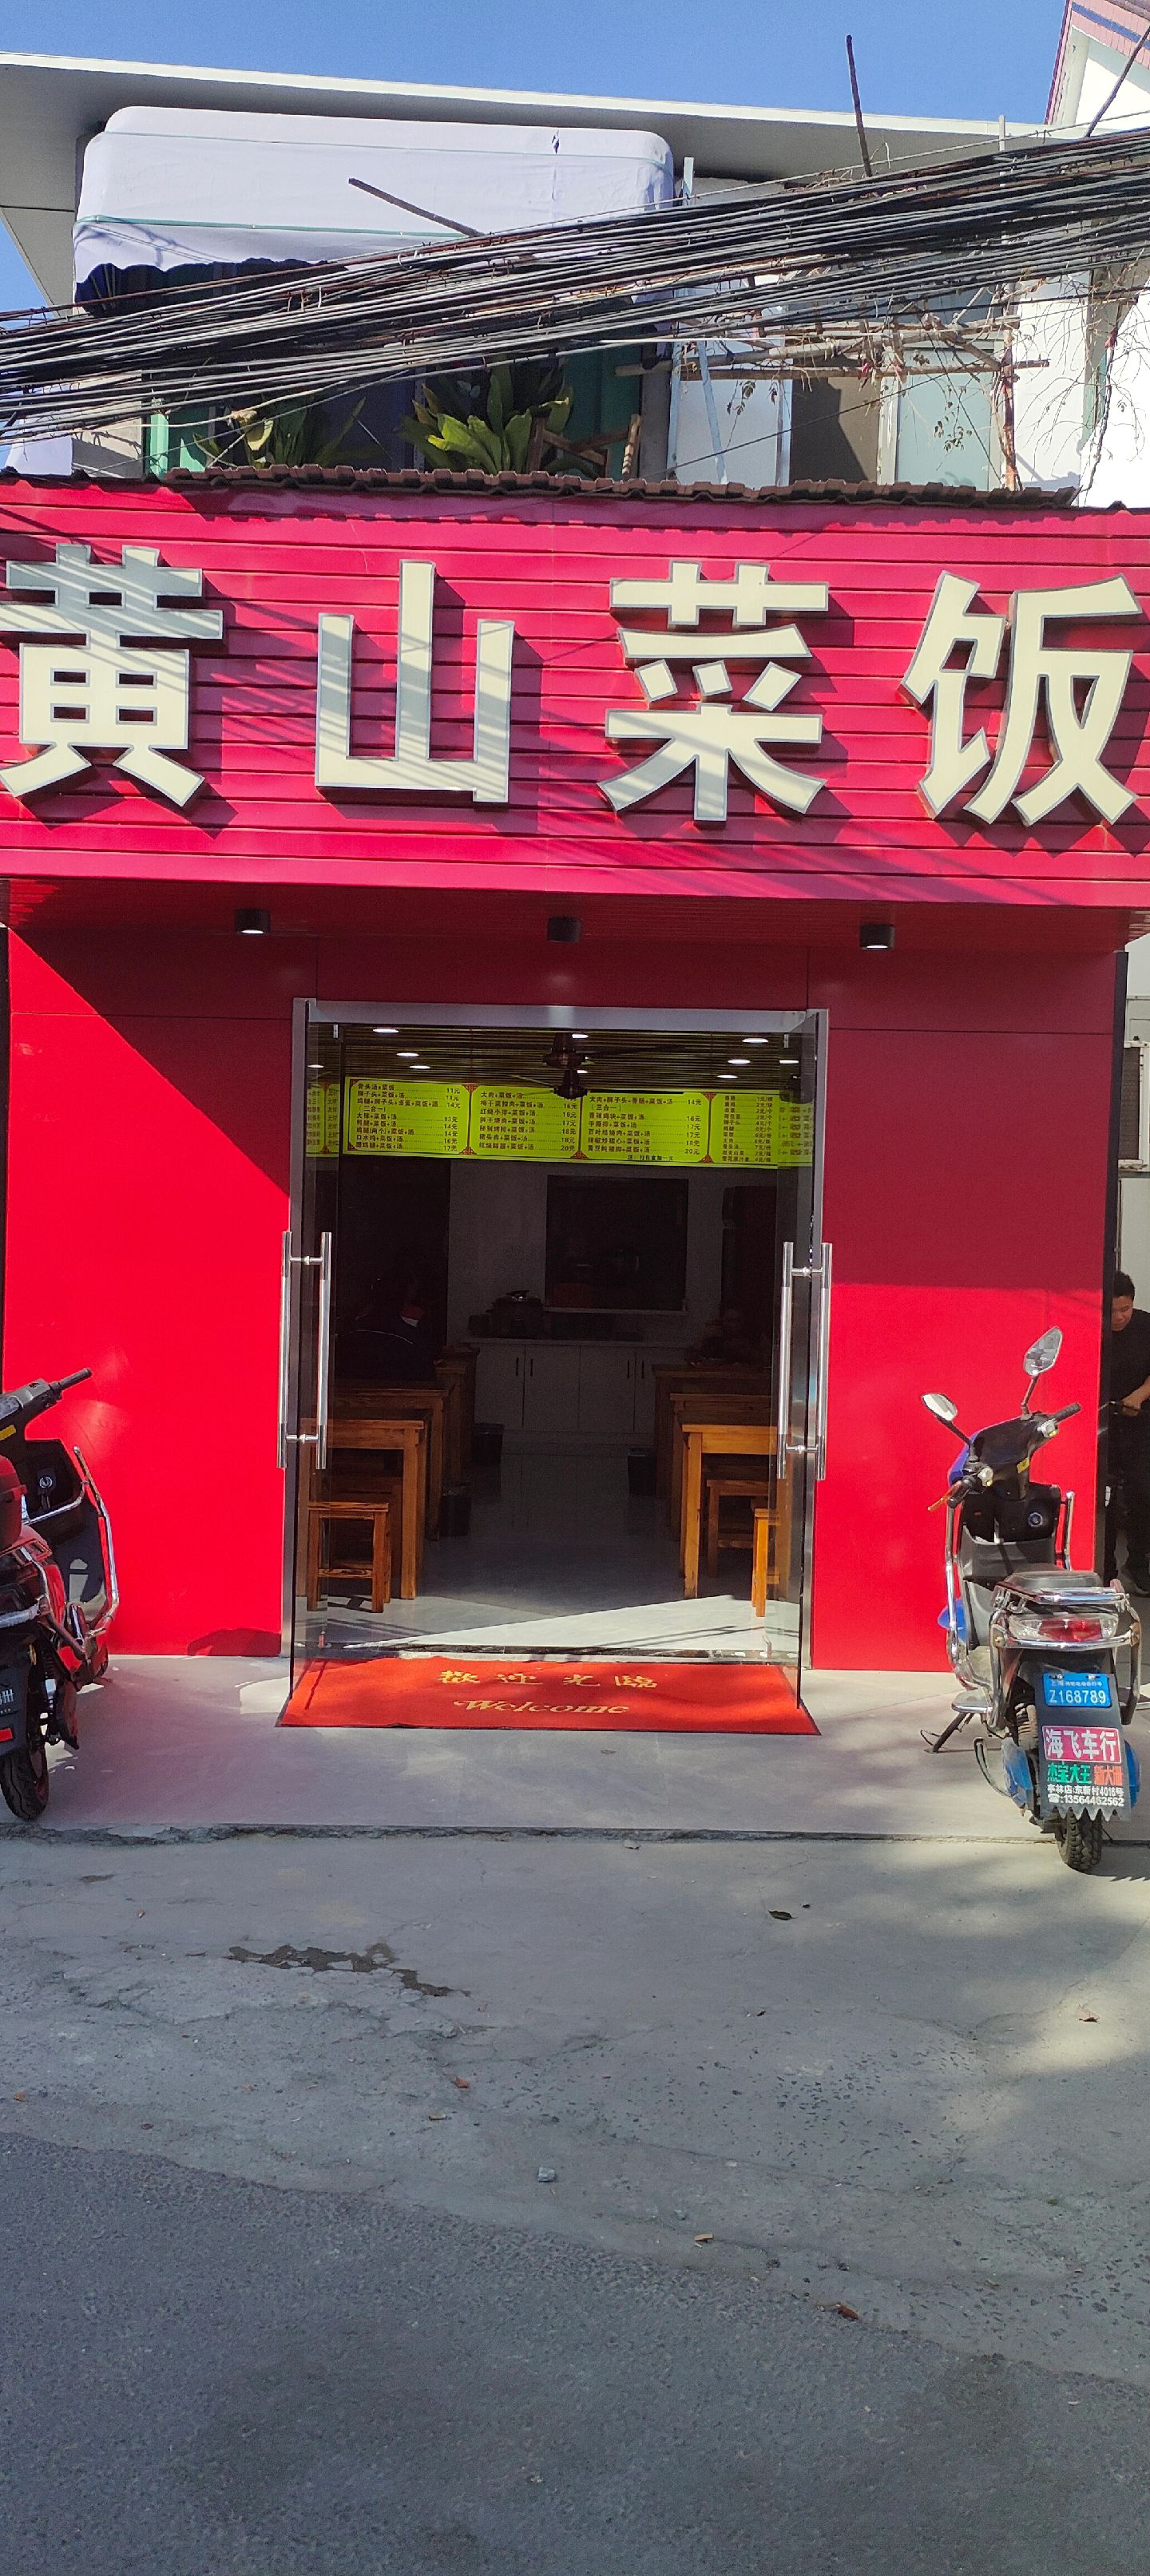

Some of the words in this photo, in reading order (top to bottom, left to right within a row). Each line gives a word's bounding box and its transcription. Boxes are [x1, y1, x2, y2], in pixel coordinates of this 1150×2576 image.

[0, 543, 1139, 826] 黄山菜饭
[453, 1700, 629, 1714] Welcome
[1049, 1689, 1107, 1704] Z168789
[1045, 1728, 1116, 1762] 海飞车行
[1047, 1761, 1092, 1784] 杰宝大王
